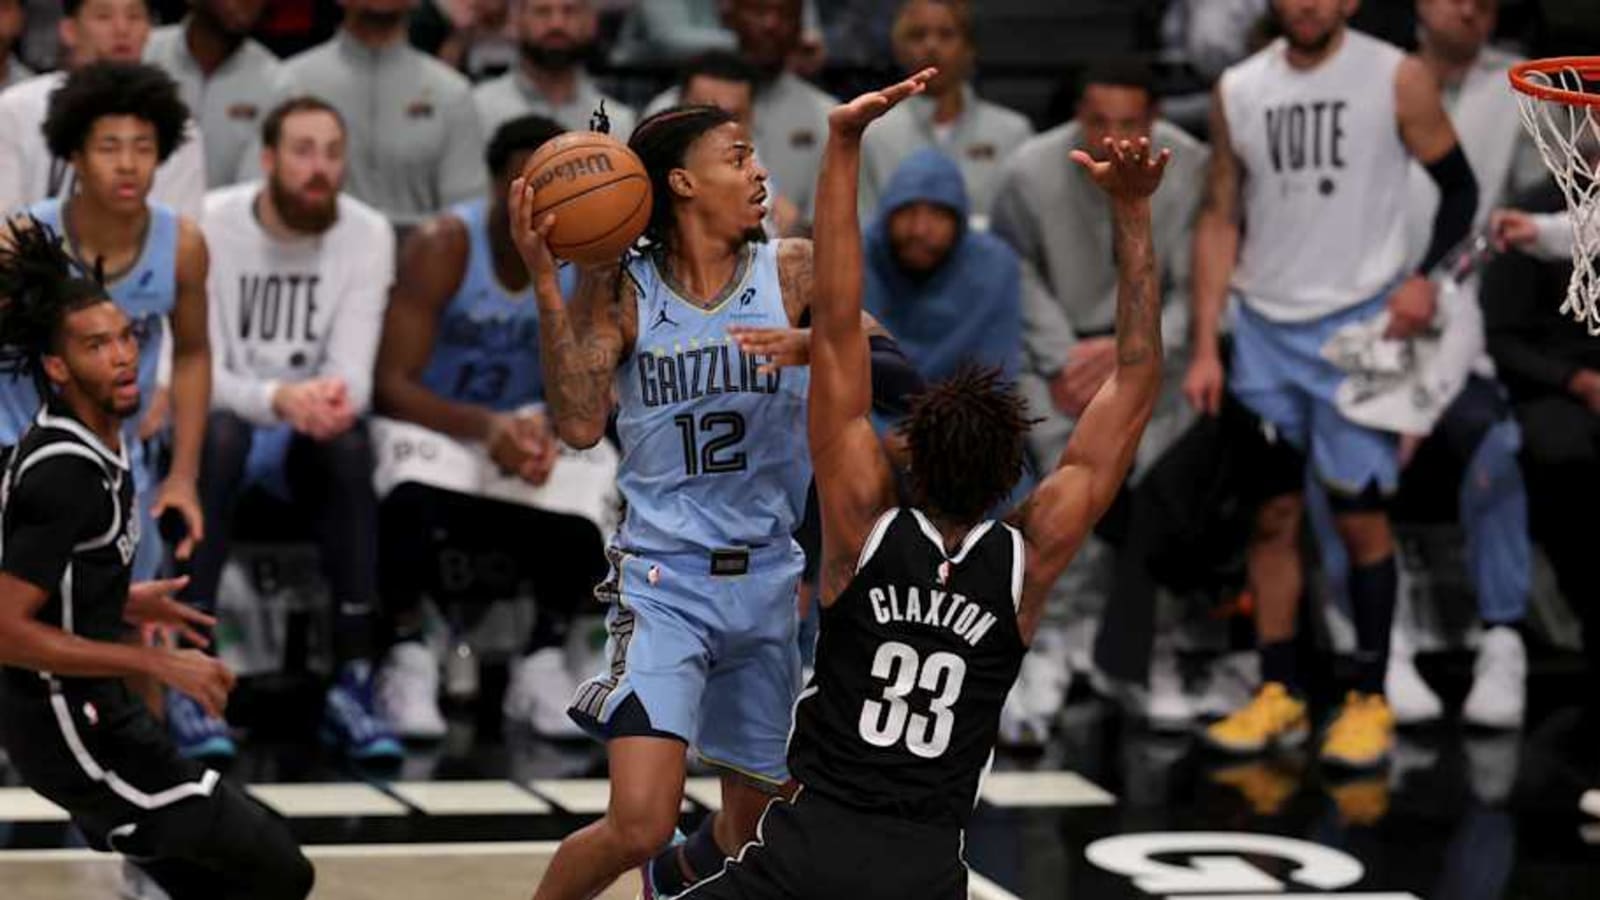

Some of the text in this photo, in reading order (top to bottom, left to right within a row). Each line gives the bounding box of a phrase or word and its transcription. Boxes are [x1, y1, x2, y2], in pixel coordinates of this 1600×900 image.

[1265, 102, 1346, 173] VOTE
[238, 274, 320, 341] VOTE
[674, 411, 747, 476] 12
[868, 584, 998, 647] CLAXTON
[858, 641, 967, 759] 33
